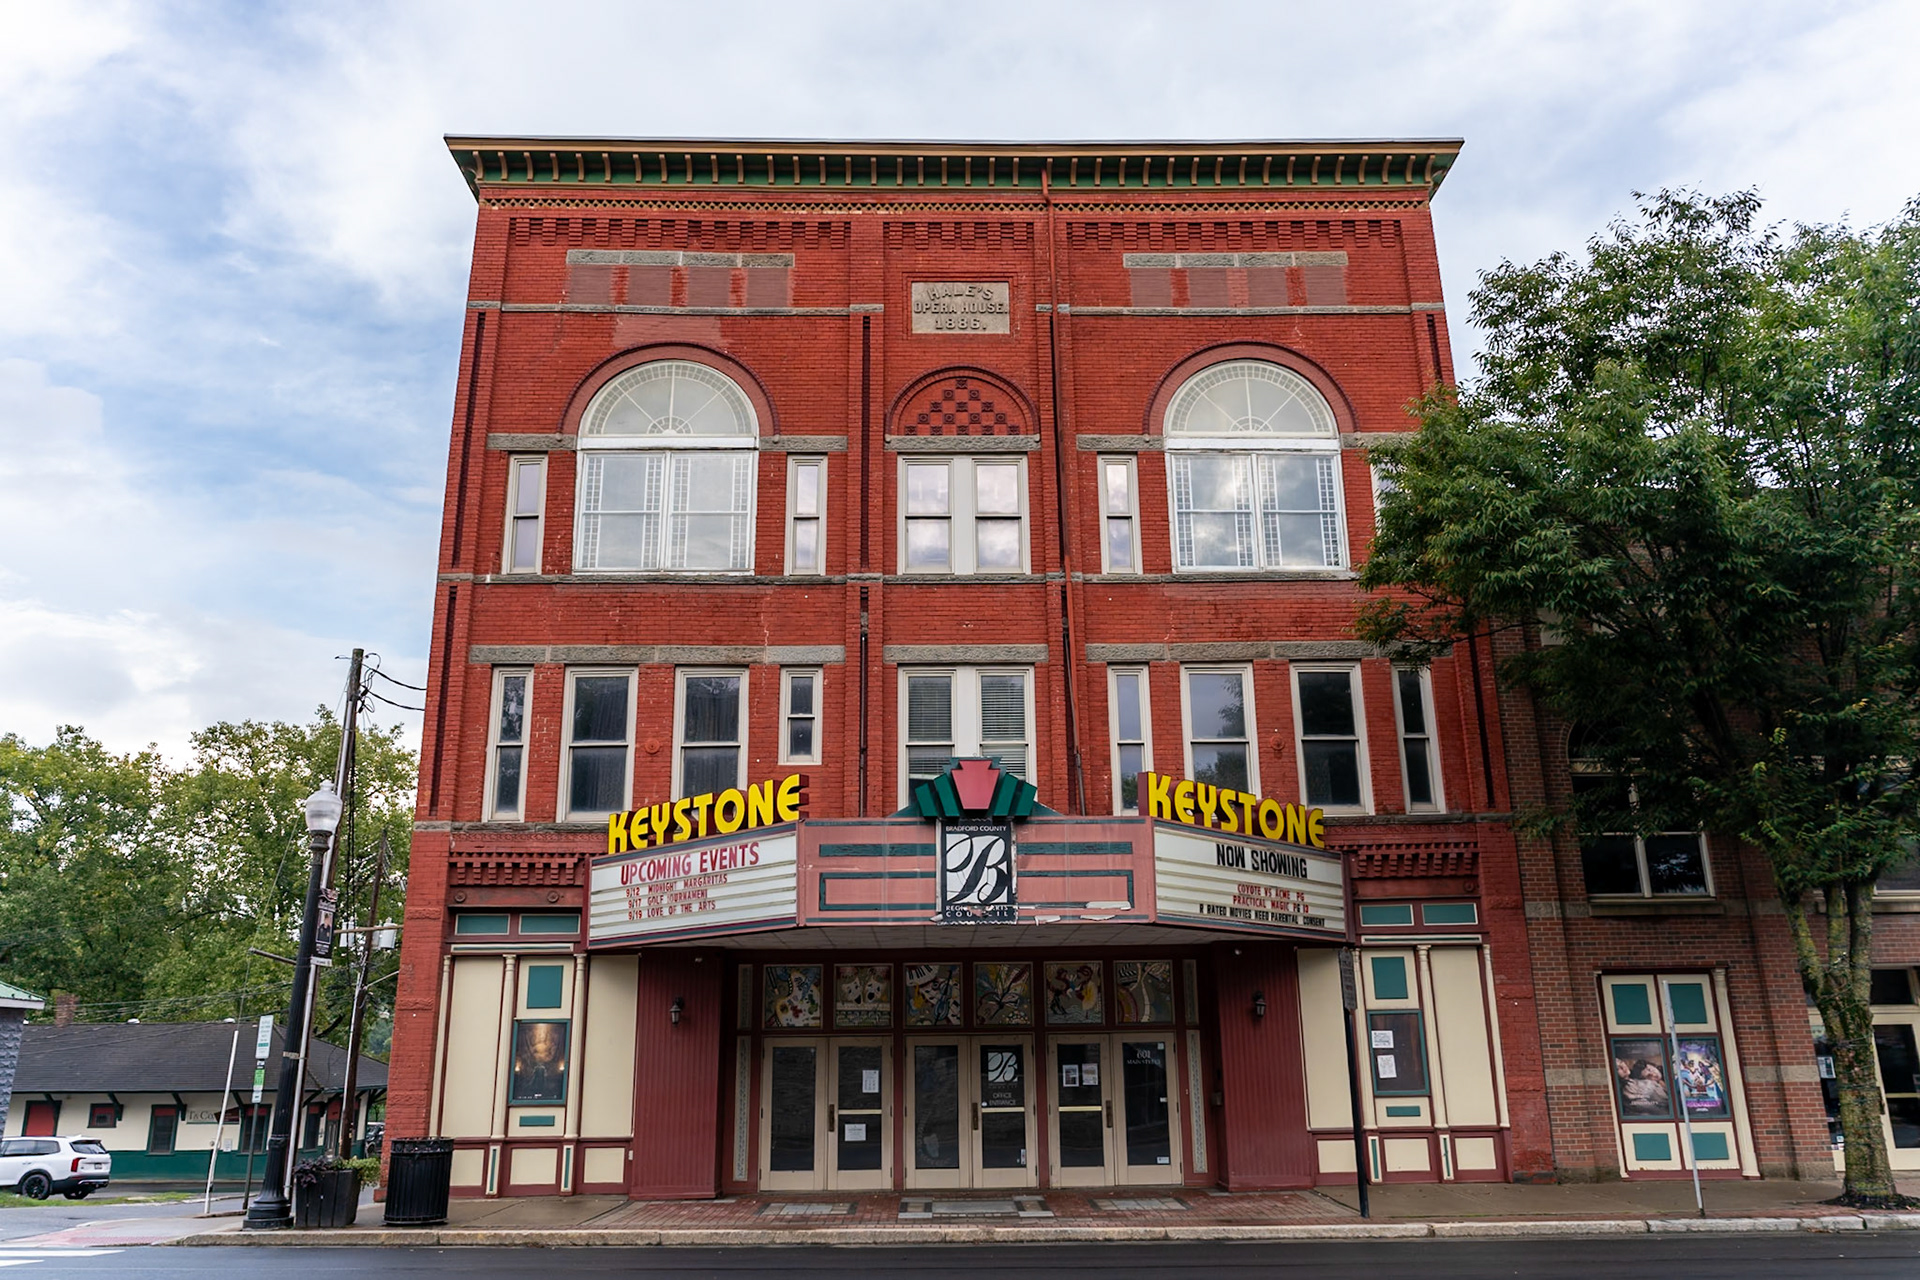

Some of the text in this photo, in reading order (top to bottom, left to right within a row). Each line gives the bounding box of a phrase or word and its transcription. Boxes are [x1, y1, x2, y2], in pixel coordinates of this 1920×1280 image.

[927, 285, 994, 301] HALE'S
[913, 302, 957, 314] OPERA
[608, 773, 802, 855] KEYSTONE
[1146, 771, 1325, 849] KEYSTONE
[620, 841, 760, 886] UPCOMING EVENTS
[1216, 843, 1308, 879] NOW SHOWING
[625, 873, 728, 898] 9/12 MIDNIGHT MARGARITAS
[1236, 883, 1305, 902] COYOTE VS ACME PG
[627, 898, 642, 910] 9/17
[646, 895, 664, 907] GOLF
[628, 900, 716, 921] 9/19 LOVE OF THE ARTS
[1232, 895, 1267, 909] PRACTICAL
[1270, 900, 1290, 913] MAGIC
[1292, 902, 1301, 914] PG
[1199, 902, 1325, 928] R RATED MOVIES NEED PARENTAL CONSENT
